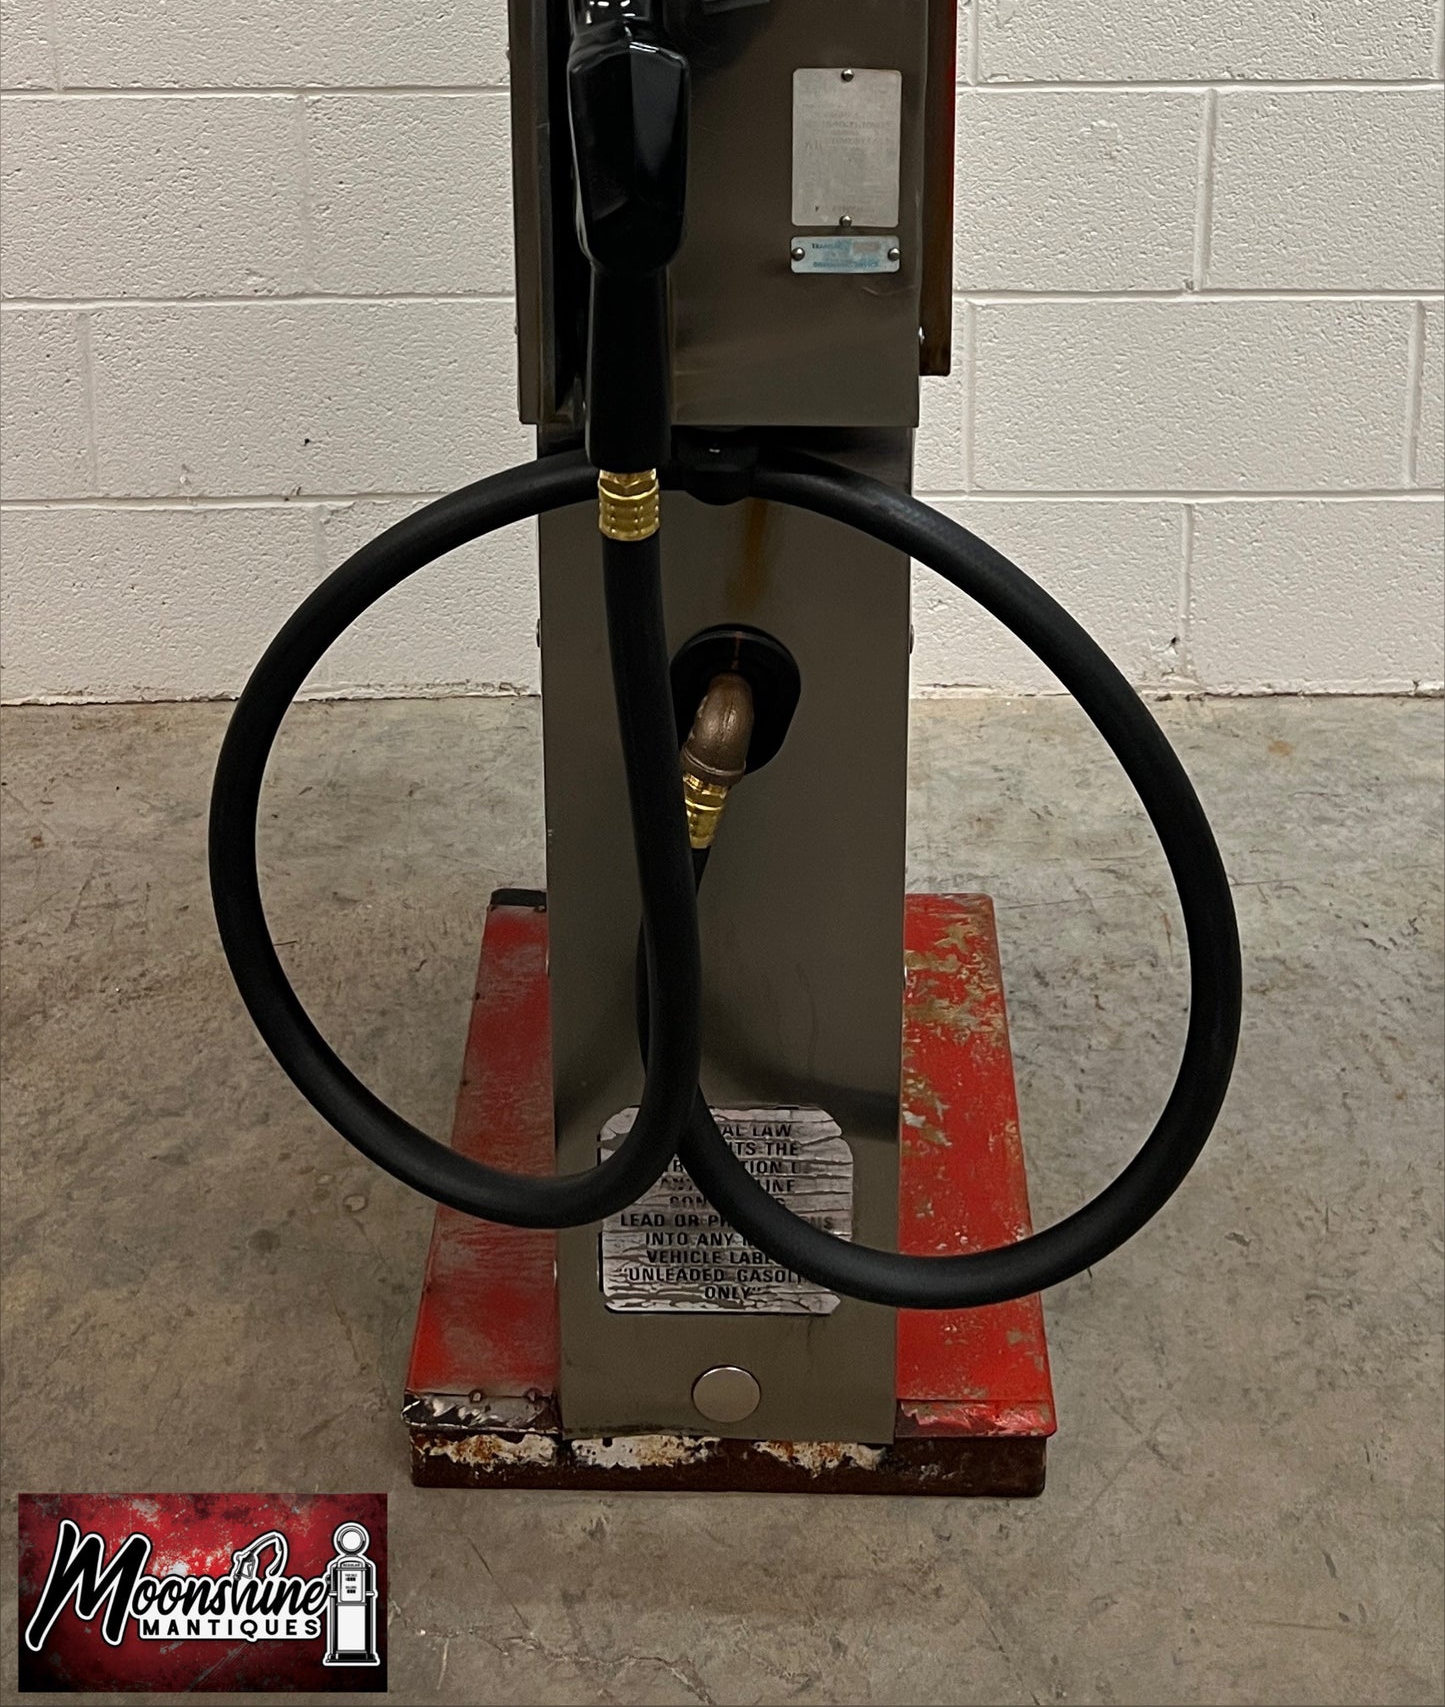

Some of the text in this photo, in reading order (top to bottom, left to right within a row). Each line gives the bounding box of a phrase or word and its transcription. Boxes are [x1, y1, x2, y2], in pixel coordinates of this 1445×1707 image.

[752, 1124, 792, 1137] LAW
[765, 1142, 799, 1156] THE
[620, 1214, 666, 1227] LEAD
[674, 1214, 700, 1227] OR
[645, 1232, 689, 1246] INTO
[696, 1232, 734, 1246] ANY
[646, 1250, 721, 1264] VEHICLE
